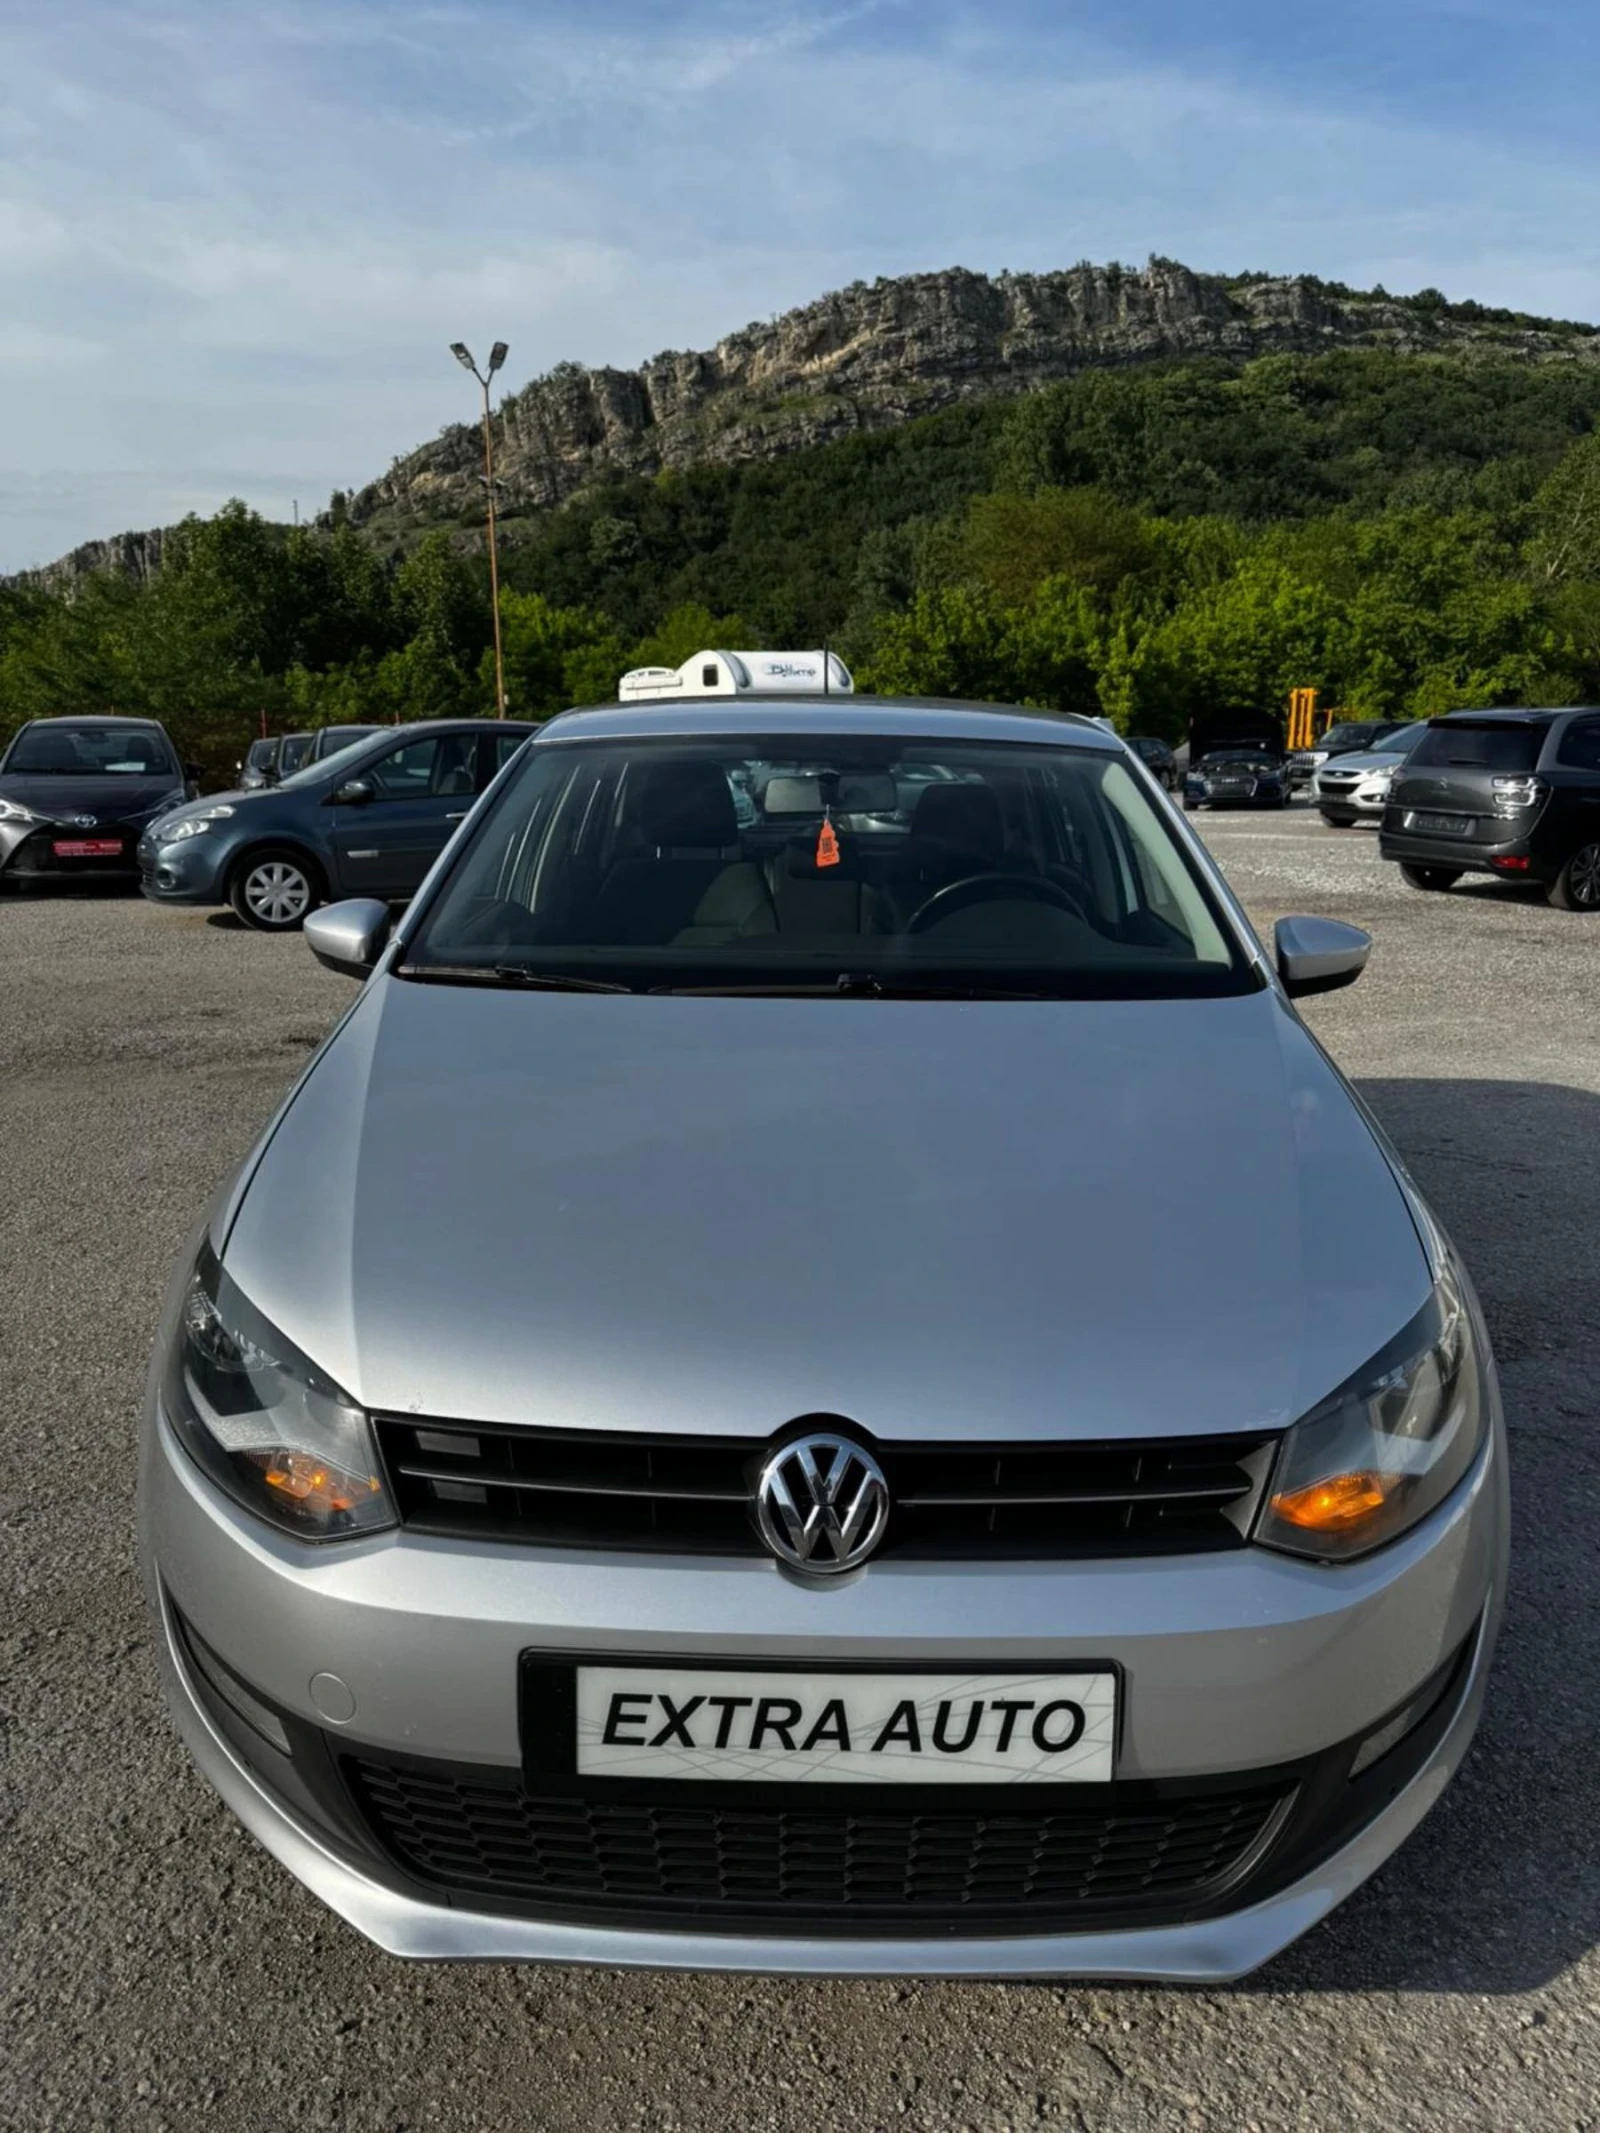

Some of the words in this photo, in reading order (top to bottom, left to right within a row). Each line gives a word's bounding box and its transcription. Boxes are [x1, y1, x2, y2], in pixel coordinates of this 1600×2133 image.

[761, 1436, 886, 1569] VW
[602, 1692, 852, 1752] EXTRA
[870, 1699, 1087, 1754] AUTO
